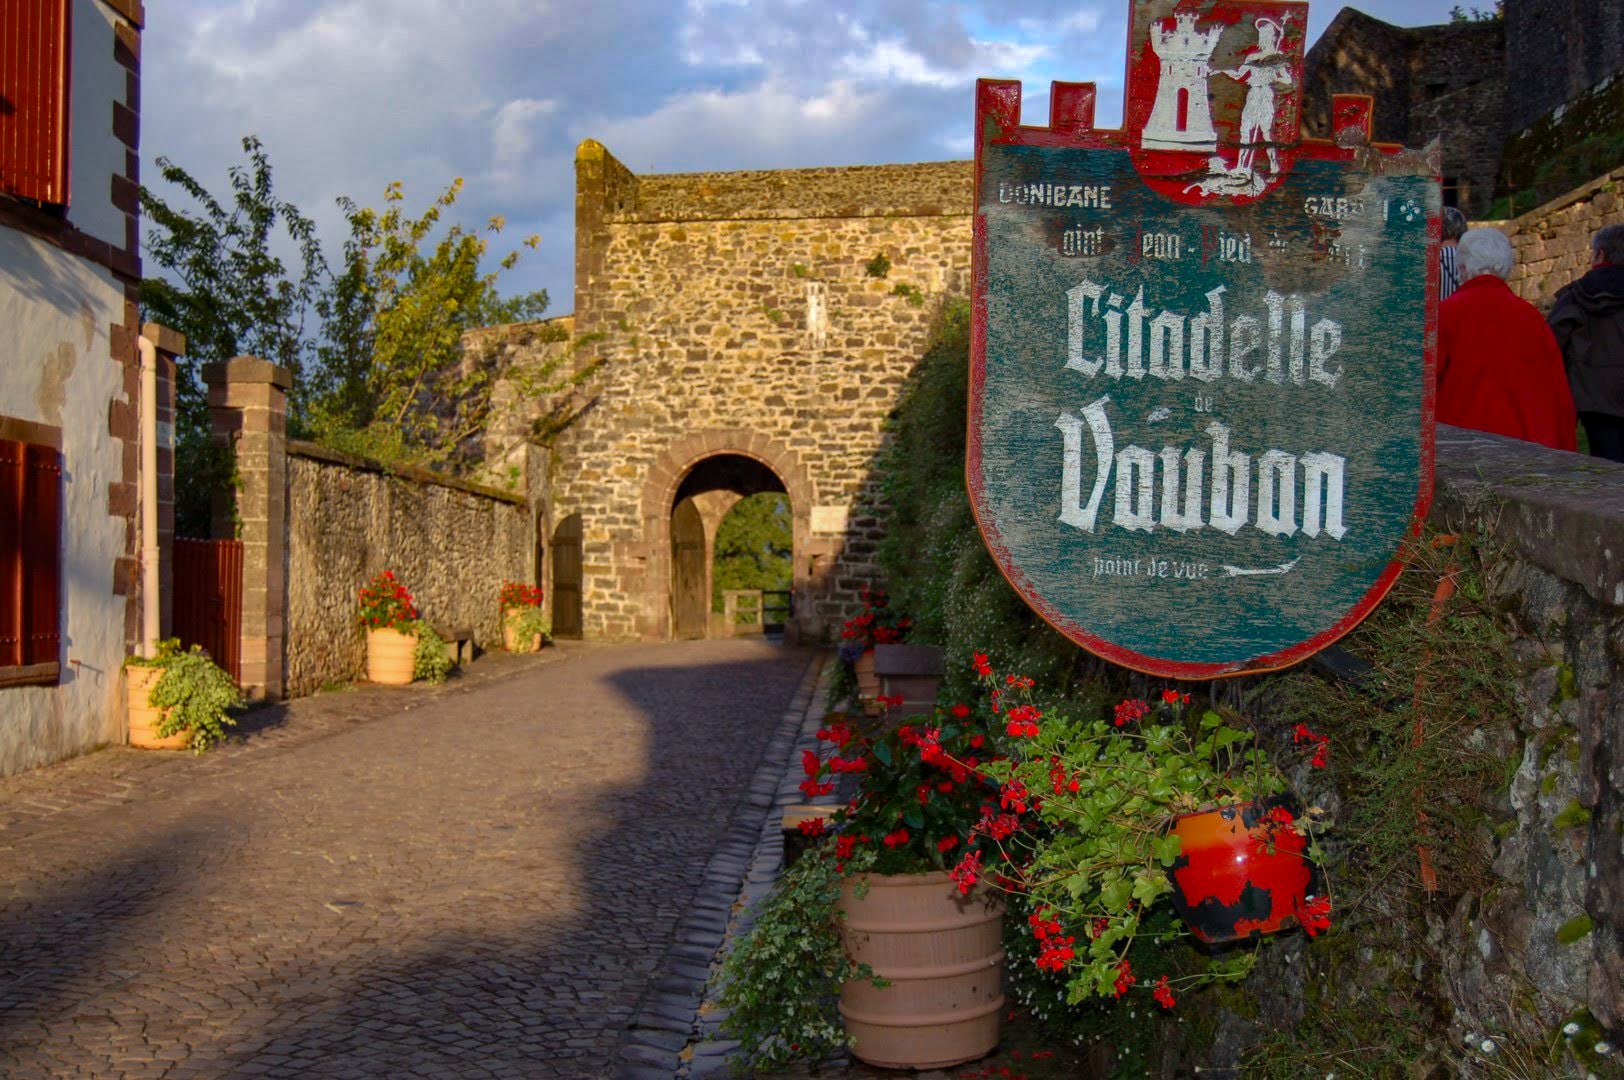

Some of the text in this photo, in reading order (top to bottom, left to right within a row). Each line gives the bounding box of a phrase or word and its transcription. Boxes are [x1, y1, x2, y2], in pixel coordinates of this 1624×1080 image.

[1064, 279, 1344, 389] Citadelle
[1053, 394, 1348, 541] Vauban
[1093, 556, 1209, 580] point de vue
